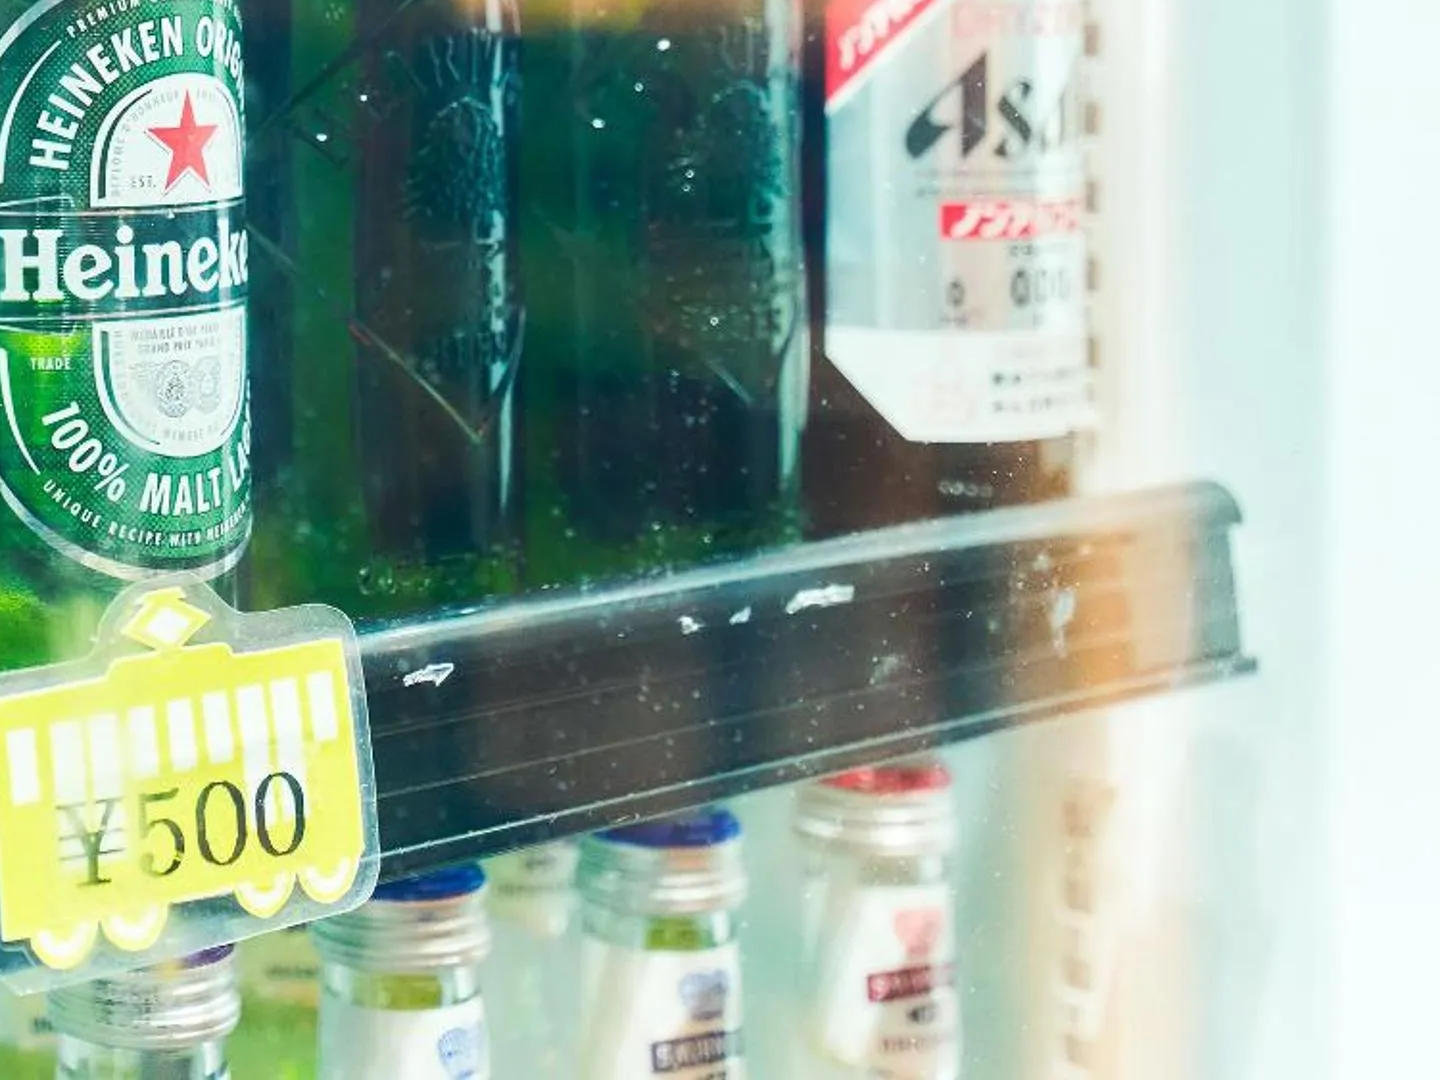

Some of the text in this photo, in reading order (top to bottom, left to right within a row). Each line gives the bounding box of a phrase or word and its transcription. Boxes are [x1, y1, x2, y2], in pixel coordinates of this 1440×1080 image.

[29, 16, 184, 170] HEINEKEN
[31, 357, 72, 370] TRADE
[42, 402, 130, 502] 100%
[139, 468, 222, 517] MALT
[43, 480, 101, 529] UNIQUE
[109, 520, 162, 546] RECIPE
[170, 529, 201, 548] WITH
[56, 771, 307, 888] ¥500
